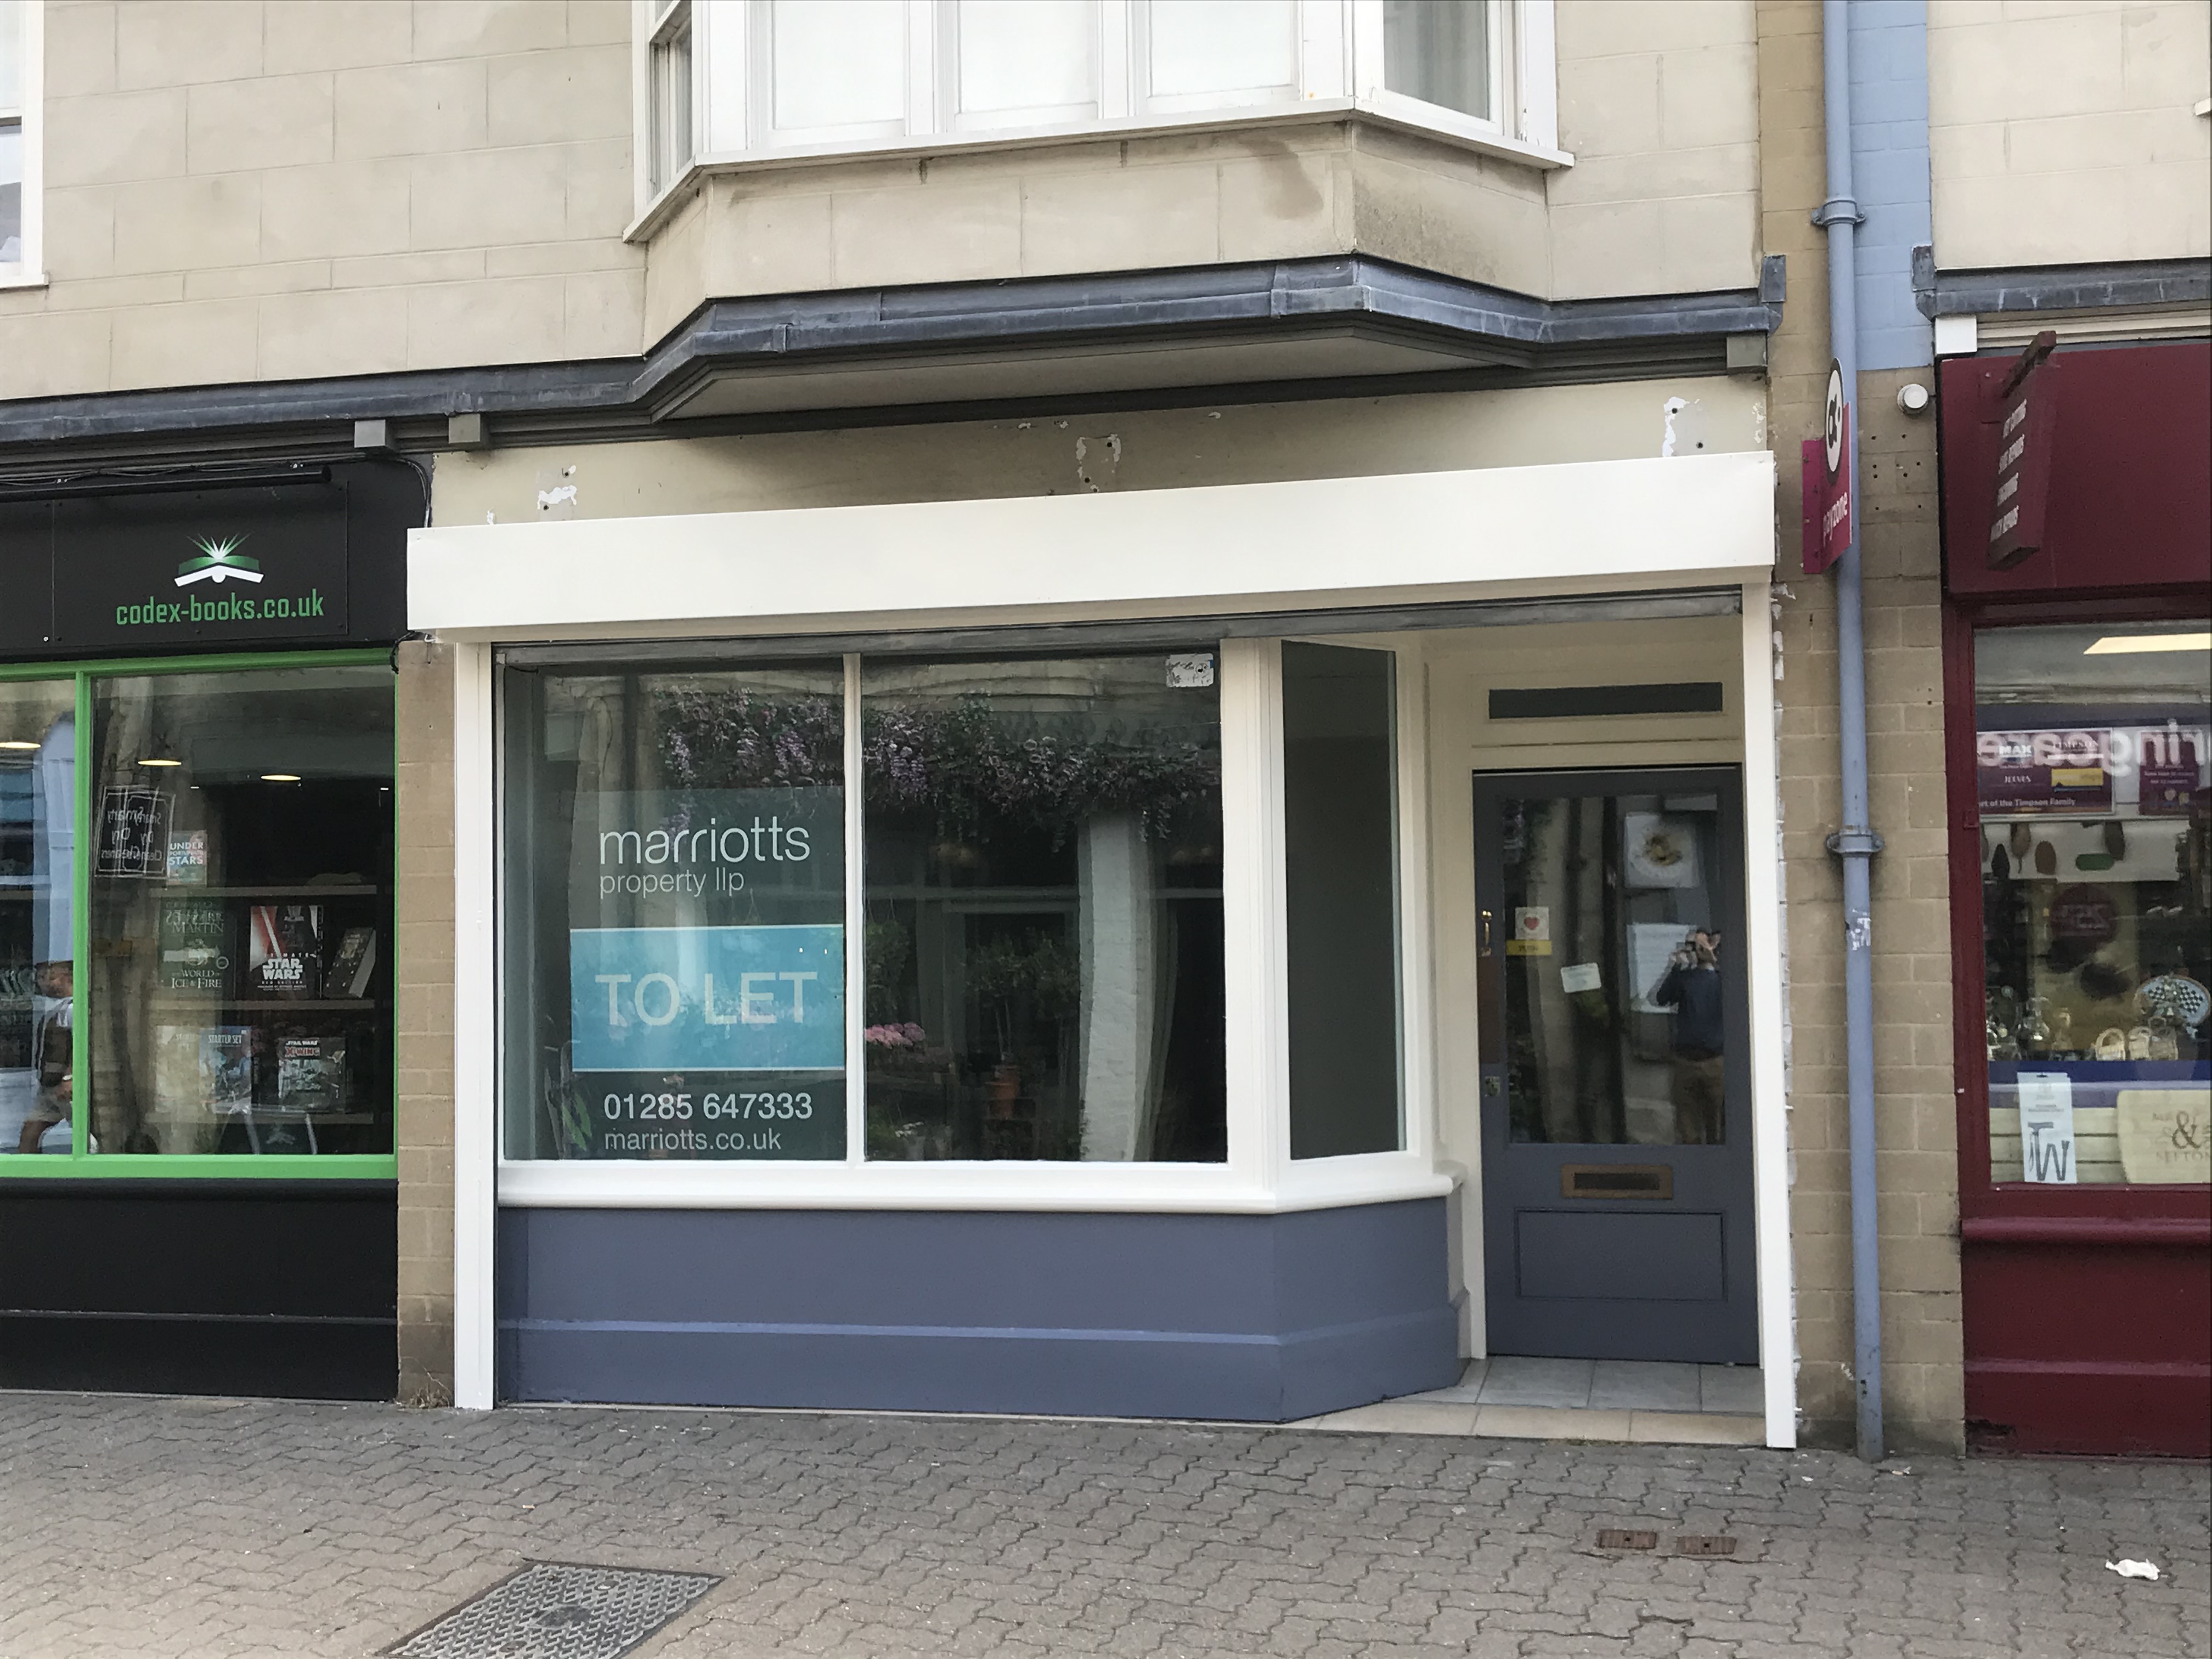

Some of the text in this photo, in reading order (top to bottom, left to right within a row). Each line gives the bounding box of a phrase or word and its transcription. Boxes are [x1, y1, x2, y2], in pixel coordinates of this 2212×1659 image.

[116, 588, 324, 625] codex-books.co.uk
[1989, 798, 1998, 807] of
[1999, 798, 2014, 807] the
[2015, 797, 2049, 806] Timpson
[2050, 797, 2076, 806] Family
[170, 842, 204, 850] UNDER
[600, 816, 810, 865] marriotts
[169, 856, 204, 865] STARS
[600, 867, 744, 899] property llp
[172, 922, 224, 934] MARTIN
[262, 958, 303, 969] STAR
[181, 969, 215, 978] WORLD
[262, 969, 303, 980] WARS
[197, 977, 223, 989] FIRE
[595, 972, 818, 1026] TO LET
[232, 1034, 242, 1045] SET
[604, 1092, 813, 1120] 01285 647333
[605, 1128, 782, 1150] marriotts.co.uk
